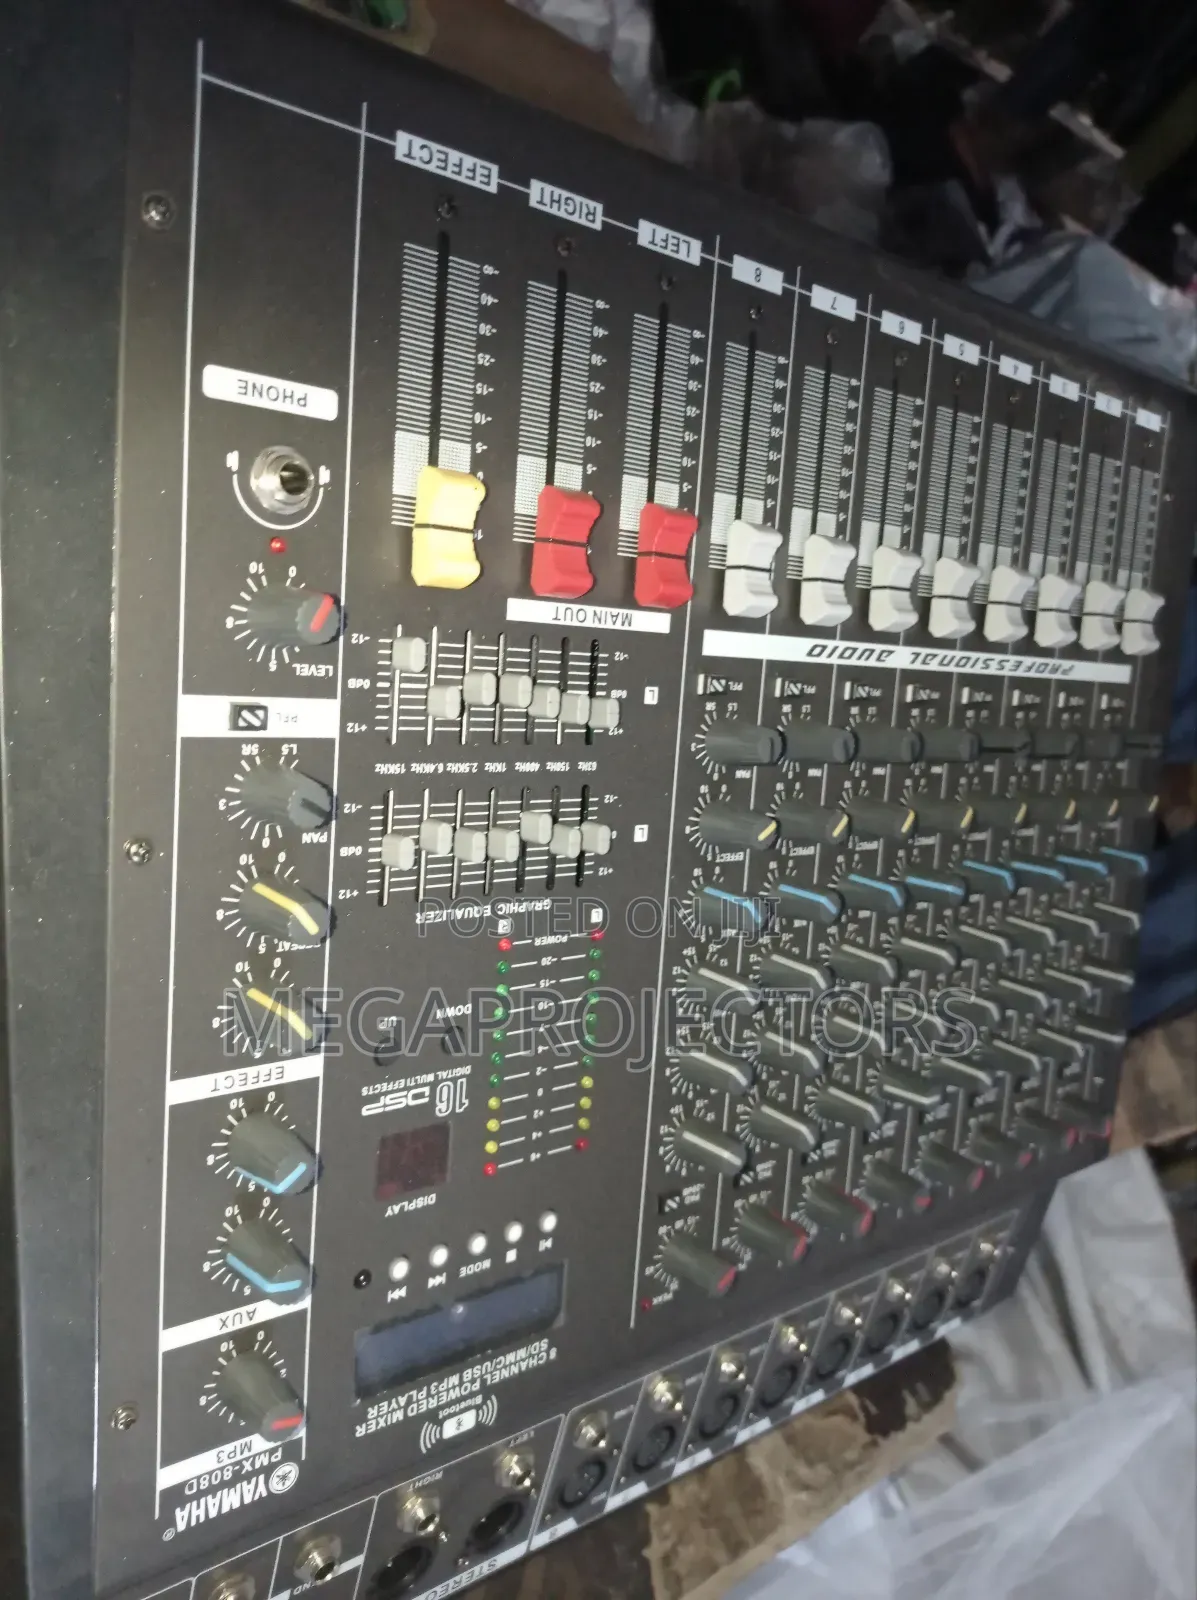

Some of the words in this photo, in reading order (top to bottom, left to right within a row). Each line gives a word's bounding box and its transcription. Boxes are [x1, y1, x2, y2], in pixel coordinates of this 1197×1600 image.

[402, 138, 492, 186] EFFECT
[535, 186, 597, 225] RIGHT
[647, 226, 692, 260] LEFT
[754, 268, 762, 282] 8
[480, 293, 499, 305] -40
[830, 296, 838, 310] 7
[478, 323, 497, 335] -30
[592, 326, 609, 337] -40
[898, 321, 906, 334] 6
[958, 344, 965, 356] 5
[477, 353, 496, 366] -25
[591, 353, 607, 365] -30
[237, 377, 308, 407] PHONE
[475, 382, 494, 395] -15
[589, 381, 606, 392] -25
[587, 408, 604, 419] -15
[686, 405, 701, 416] -25
[474, 412, 493, 424] -10
[585, 435, 602, 447] -10
[684, 431, 699, 442] -15
[475, 442, 488, 453] -5
[682, 456, 697, 467] -10
[586, 464, 598, 474] -5
[682, 482, 693, 493] -5
[249, 562, 264, 575] 10
[289, 566, 297, 577] 0
[551, 605, 586, 624] OUT
[590, 608, 633, 628] MAIN
[226, 617, 234, 628] 8
[351, 633, 370, 644] -12
[615, 652, 629, 660] -12
[805, 643, 896, 664] AUDIO
[269, 660, 277, 671] 5
[292, 662, 334, 677] LEVEL
[908, 652, 1075, 676] PROFESSIONAL
[348, 678, 370, 689] 0dB
[727, 681, 743, 691] PFL
[611, 689, 628, 699] 0dB
[647, 689, 656, 701] L
[276, 712, 298, 724] PFL
[346, 722, 367, 733] +12
[609, 726, 624, 735] +12
[374, 763, 406, 774] 15KHz
[410, 762, 444, 773] 6.4KHz
[446, 762, 479, 773] 2.5KHz
[484, 762, 507, 772] 1KHz
[735, 769, 751, 779] PAN
[218, 799, 227, 810] 3
[604, 794, 618, 803] -12
[343, 802, 362, 814] -12
[302, 831, 328, 844] PAN
[637, 828, 646, 839] L
[262, 836, 270, 848] 0
[278, 851, 286, 863] 0
[340, 845, 362, 857] 0dB
[716, 852, 744, 862] EFFECT
[239, 853, 254, 866] 10
[598, 866, 614, 876] +12
[338, 888, 359, 900] +12
[497, 898, 552, 915] GRAPHIC
[216, 909, 224, 920] 8
[416, 905, 491, 924] EQUALIZER
[534, 934, 568, 946] POWER
[258, 943, 266, 954] 5
[273, 957, 281, 969] 0
[541, 956, 558, 965] -20
[235, 961, 250, 973] 10
[539, 978, 556, 988] -15
[538, 999, 554, 1010] -10
[435, 1003, 472, 1019] DOWN
[212, 1017, 220, 1028] 8
[378, 1016, 397, 1029] UP
[436, 1065, 472, 1080] DIGITAL
[536, 1066, 548, 1075] -2
[210, 1065, 285, 1093] EFFECT
[406, 1072, 435, 1087] MULTI
[361, 1078, 405, 1097] EFFECTS
[537, 1087, 543, 1096] 0
[268, 1091, 276, 1102] 0
[361, 1086, 430, 1117] DSP
[435, 1077, 469, 1117] 16
[229, 1097, 244, 1109] 10
[533, 1109, 544, 1118] +2
[206, 1154, 215, 1166] 8
[248, 1181, 256, 1192] 5
[262, 1196, 270, 1208] 0
[384, 1193, 437, 1217] DISPLAY
[224, 1204, 239, 1217] 10
[202, 1261, 211, 1272] 8
[459, 1258, 491, 1277] MODE
[243, 1284, 251, 1296] 5
[218, 1307, 257, 1330] AUX
[256, 1329, 265, 1341] 0
[220, 1340, 234, 1354] 10
[550, 1347, 558, 1359] 8
[462, 1338, 549, 1383] SD/MMC/USB
[482, 1349, 548, 1386] CHANNEL
[429, 1373, 460, 1396] MP3
[199, 1395, 207, 1406] 8
[366, 1388, 428, 1419] PLAYER
[407, 1383, 480, 1418] POWERED
[354, 1408, 405, 1438] MIXER
[215, 1438, 253, 1464] MP3
[185, 1446, 283, 1496] PMX-808D
[408, 1469, 444, 1492] RIGHT
[174, 1473, 268, 1533] YAMAHA
[424, 1558, 498, 1600] STEREO
